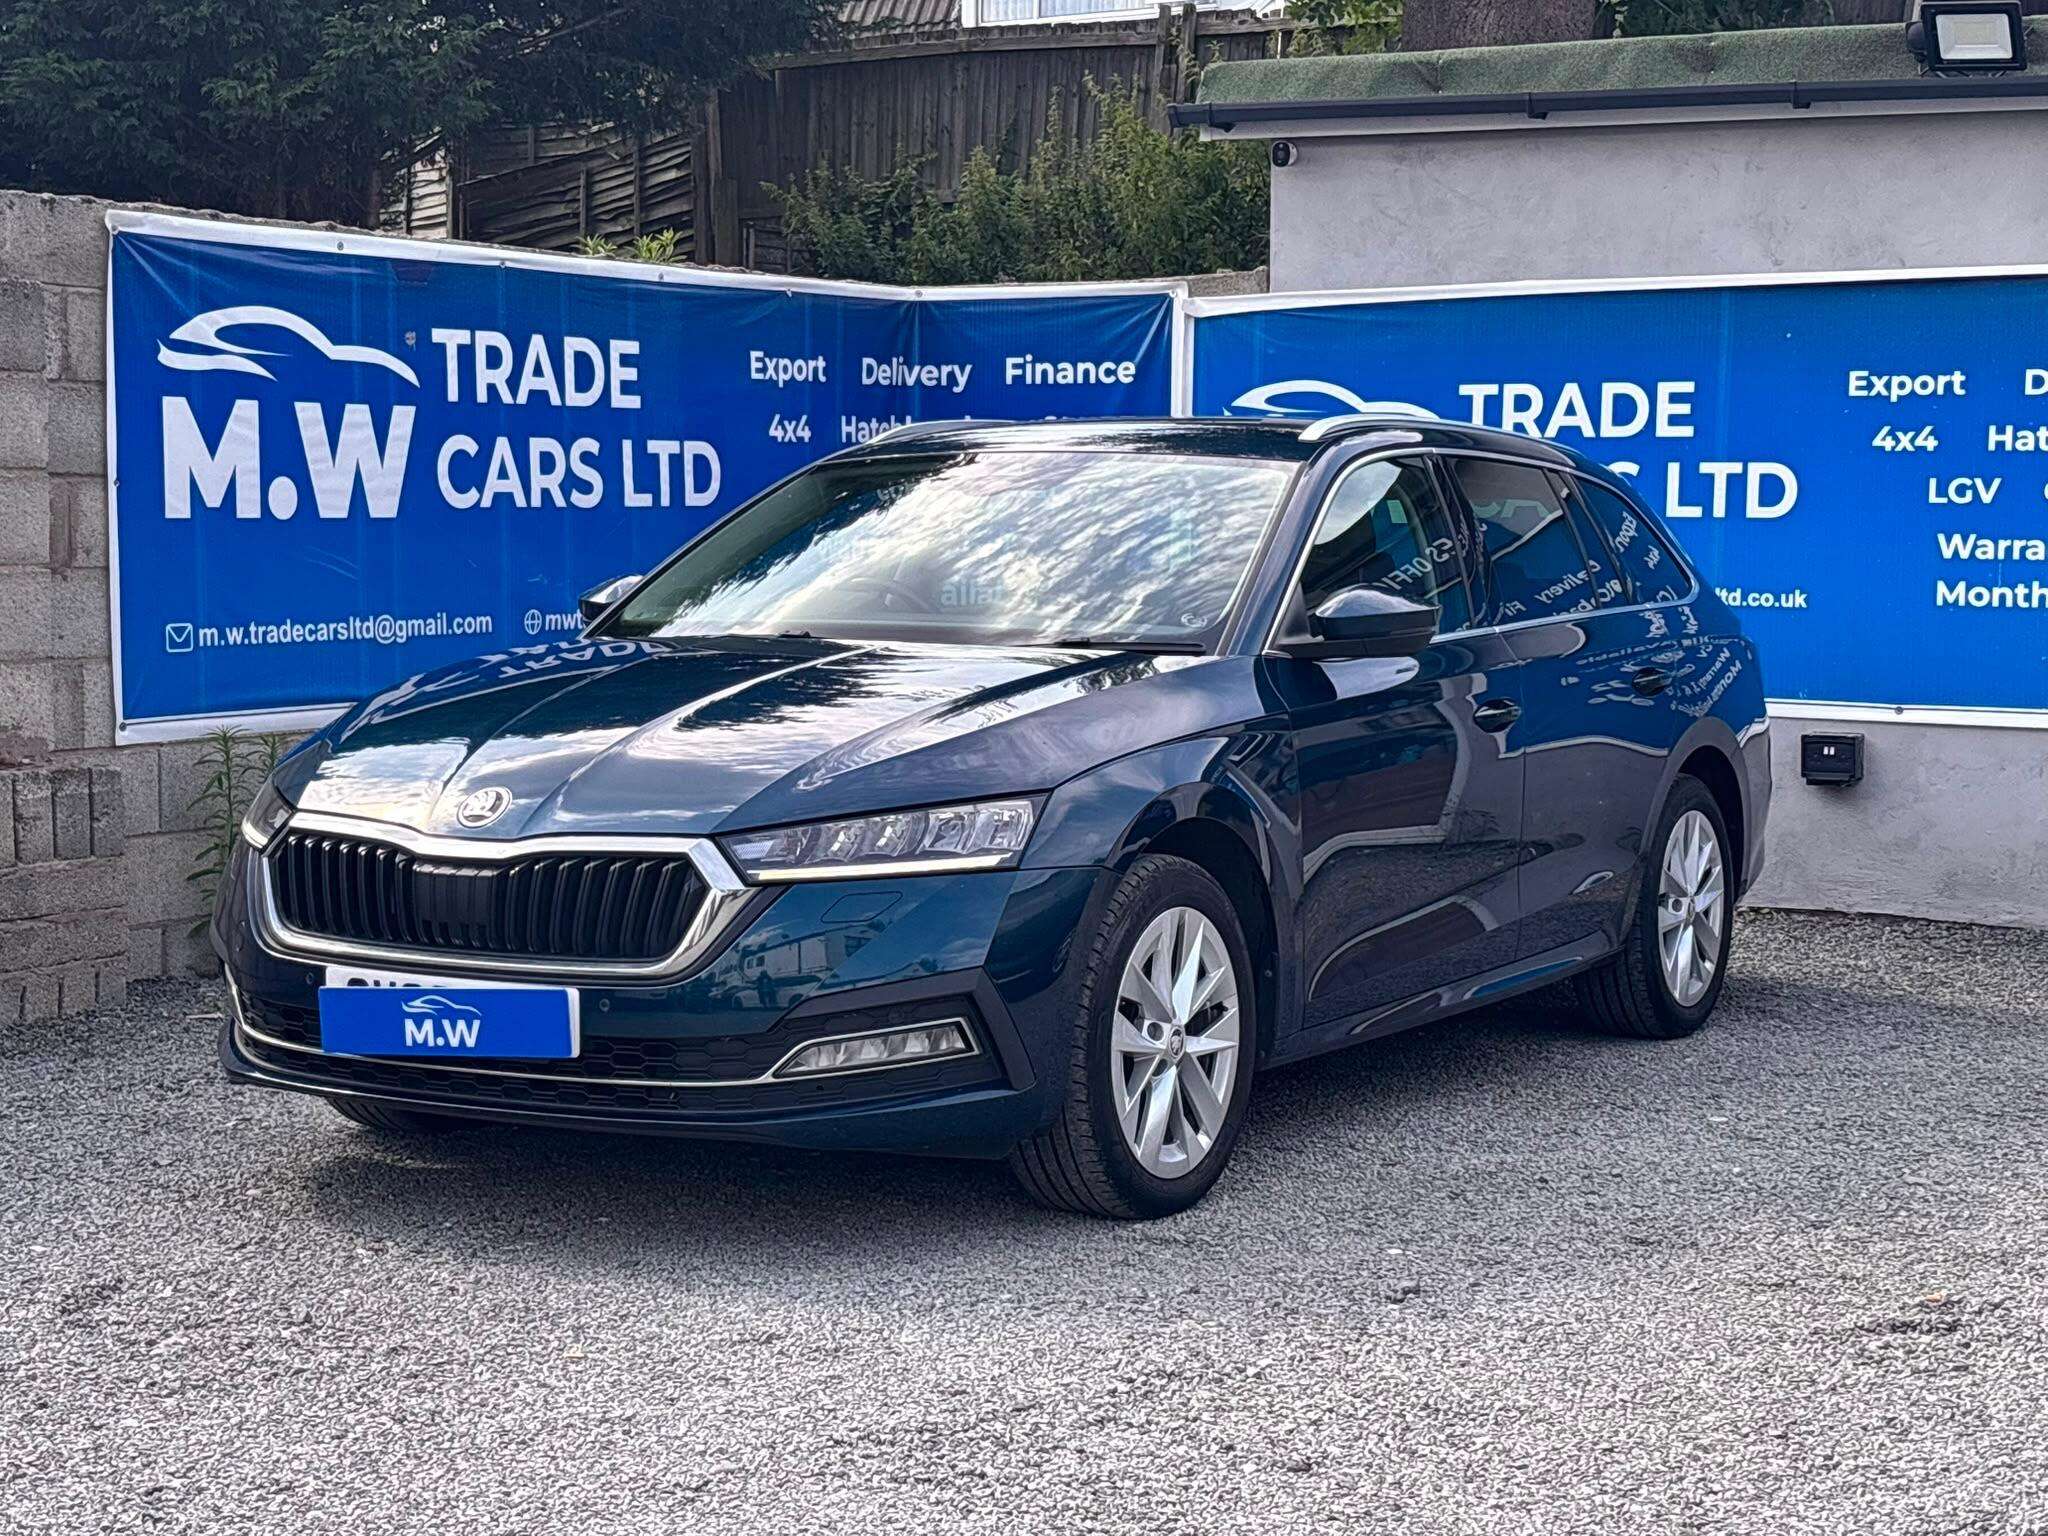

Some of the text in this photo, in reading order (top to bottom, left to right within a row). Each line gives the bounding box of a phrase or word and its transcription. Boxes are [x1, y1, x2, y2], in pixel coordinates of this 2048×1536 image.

[431, 327, 641, 410] TRADE
[749, 351, 1137, 393] Export Delivery Finance
[1848, 370, 1966, 403] Export
[1458, 381, 1697, 439] TRADE
[768, 414, 812, 443] 4x4
[1871, 425, 1939, 452] 4x4
[162, 395, 417, 521] M.W
[437, 435, 721, 510] CARS LTD
[1665, 461, 1798, 519] LTD
[1928, 477, 2002, 504] LGV
[1937, 533, 2047, 561] Warra
[198, 612, 492, 648] m.w.tradecarsltd@gmail.com
[404, 1018, 481, 1048] M.W
